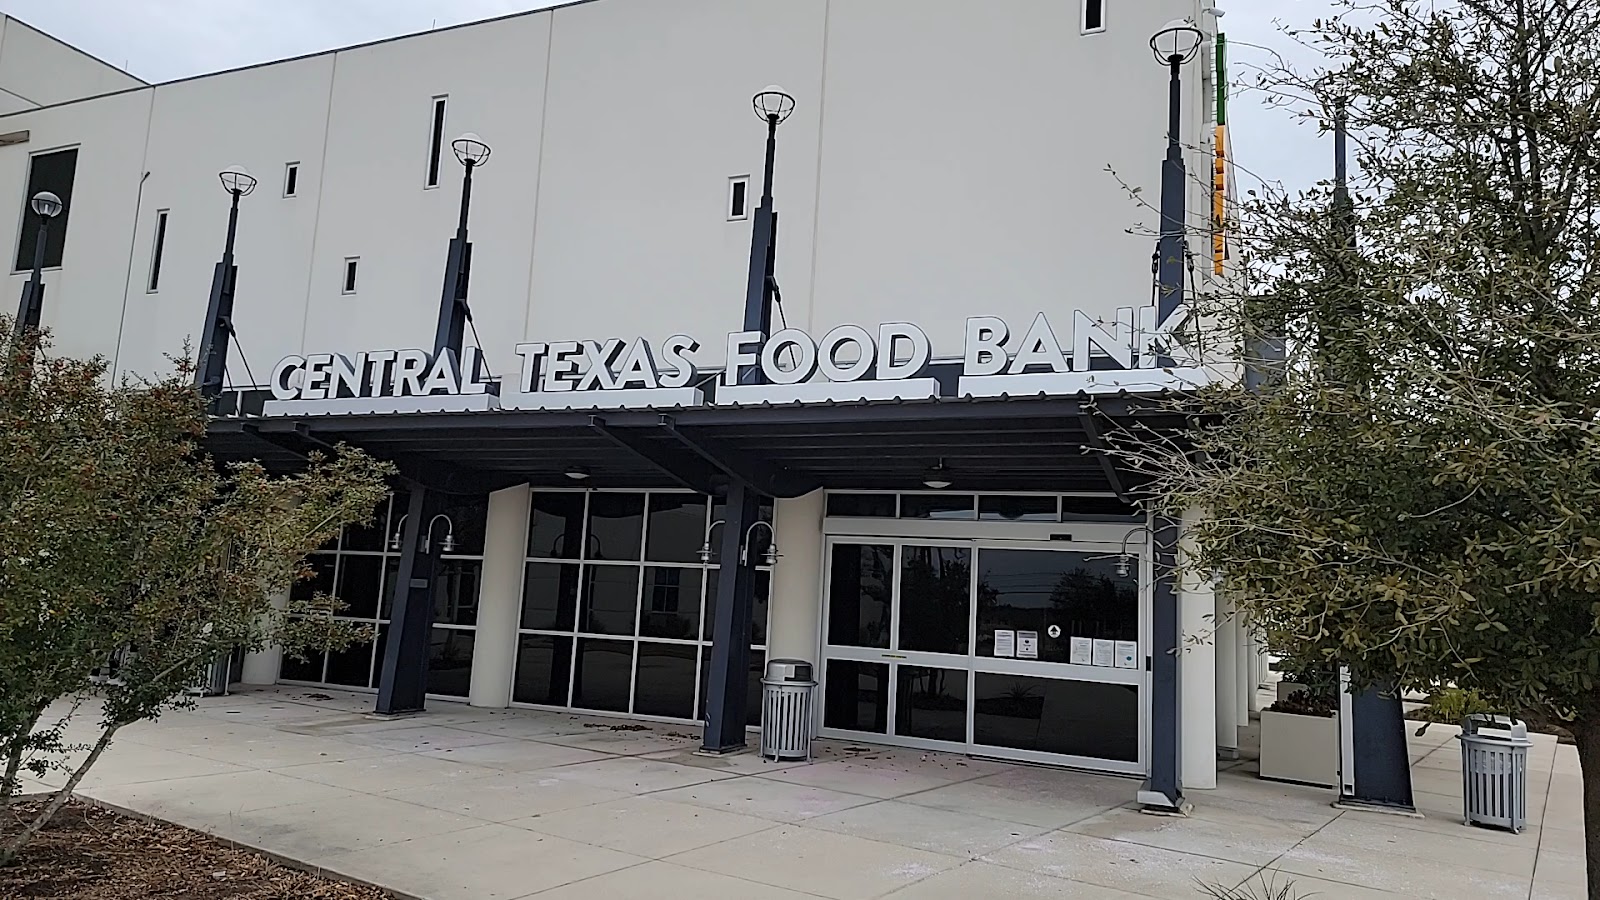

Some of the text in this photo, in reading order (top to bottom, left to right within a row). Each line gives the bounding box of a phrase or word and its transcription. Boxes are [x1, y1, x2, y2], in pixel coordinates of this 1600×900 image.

[270, 304, 1193, 400] CENTRAL TEXAS FOOD BANK
